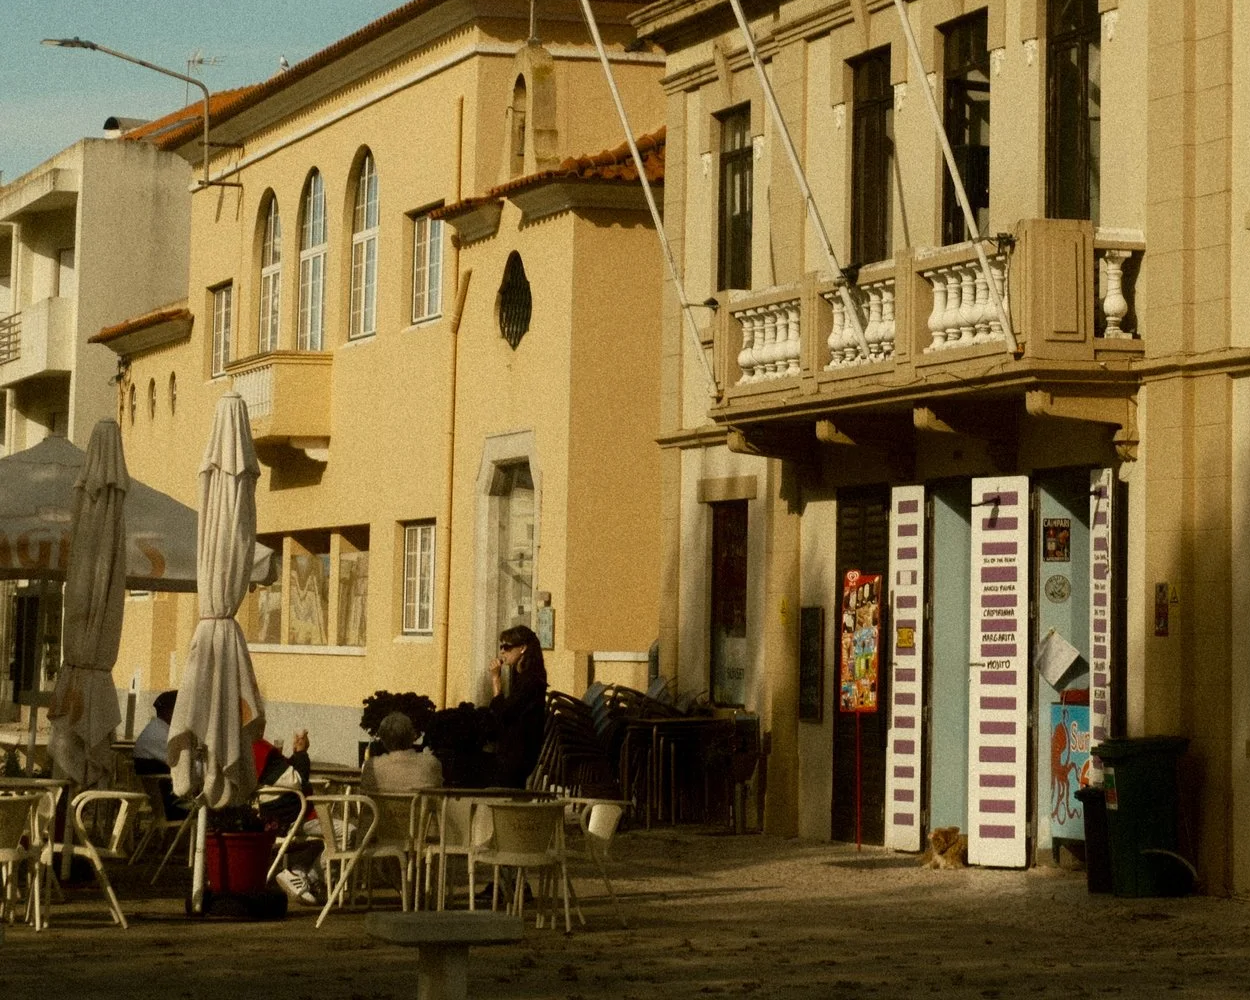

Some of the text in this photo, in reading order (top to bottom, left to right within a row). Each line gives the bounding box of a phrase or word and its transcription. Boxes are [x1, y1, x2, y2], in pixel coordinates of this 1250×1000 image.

[1043, 519, 1070, 528] CAMPARI
[982, 633, 1016, 642] MARGARITA
[987, 660, 1011, 670] MOJITO
